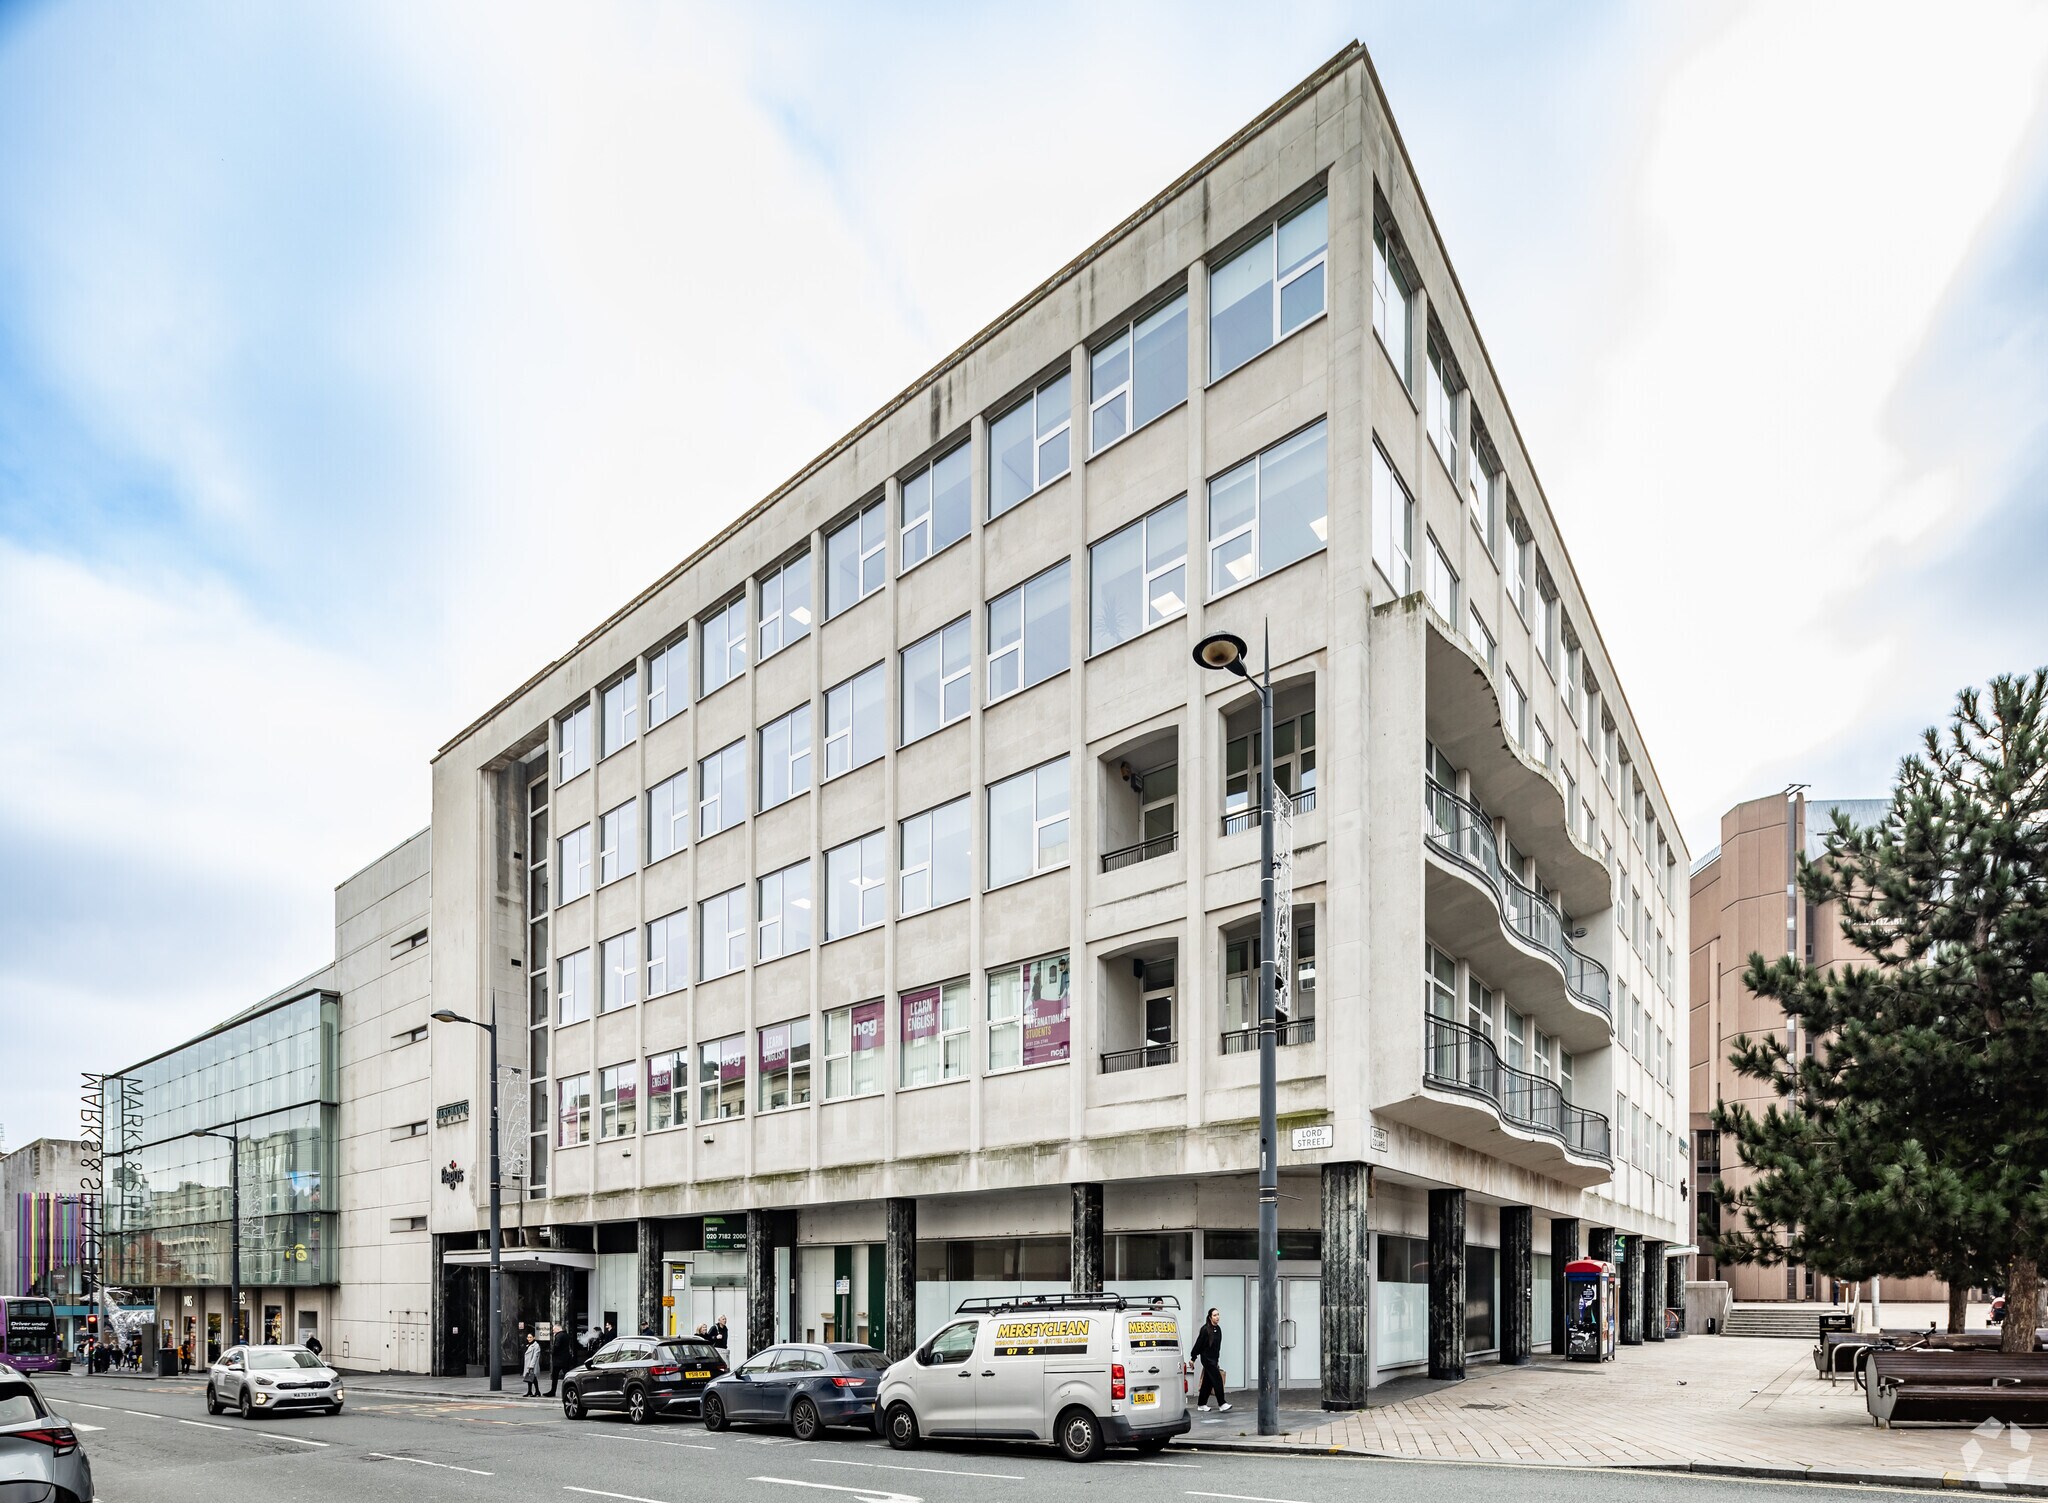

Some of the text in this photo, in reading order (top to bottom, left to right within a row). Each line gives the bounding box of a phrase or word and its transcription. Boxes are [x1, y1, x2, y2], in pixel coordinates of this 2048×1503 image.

[910, 998, 933, 1016] LEARN
[853, 1019, 877, 1037] ncg
[907, 1013, 935, 1032] ENGLISH
[1026, 1013, 1066, 1029] INTERNATIONAL
[1025, 1026, 1052, 1040] STUDENTS
[1050, 1049, 1064, 1057] ncg
[1302, 1128, 1322, 1138] LORD
[1373, 1129, 1385, 1140] DERBY
[1297, 1138, 1326, 1147] STREET
[441, 1167, 464, 1191] Regus
[996, 1320, 1090, 1339] MERSEYCLEAN
[1128, 1321, 1177, 1334] MERSEYCLEAN
[1007, 1347, 1035, 1355] 07 2
